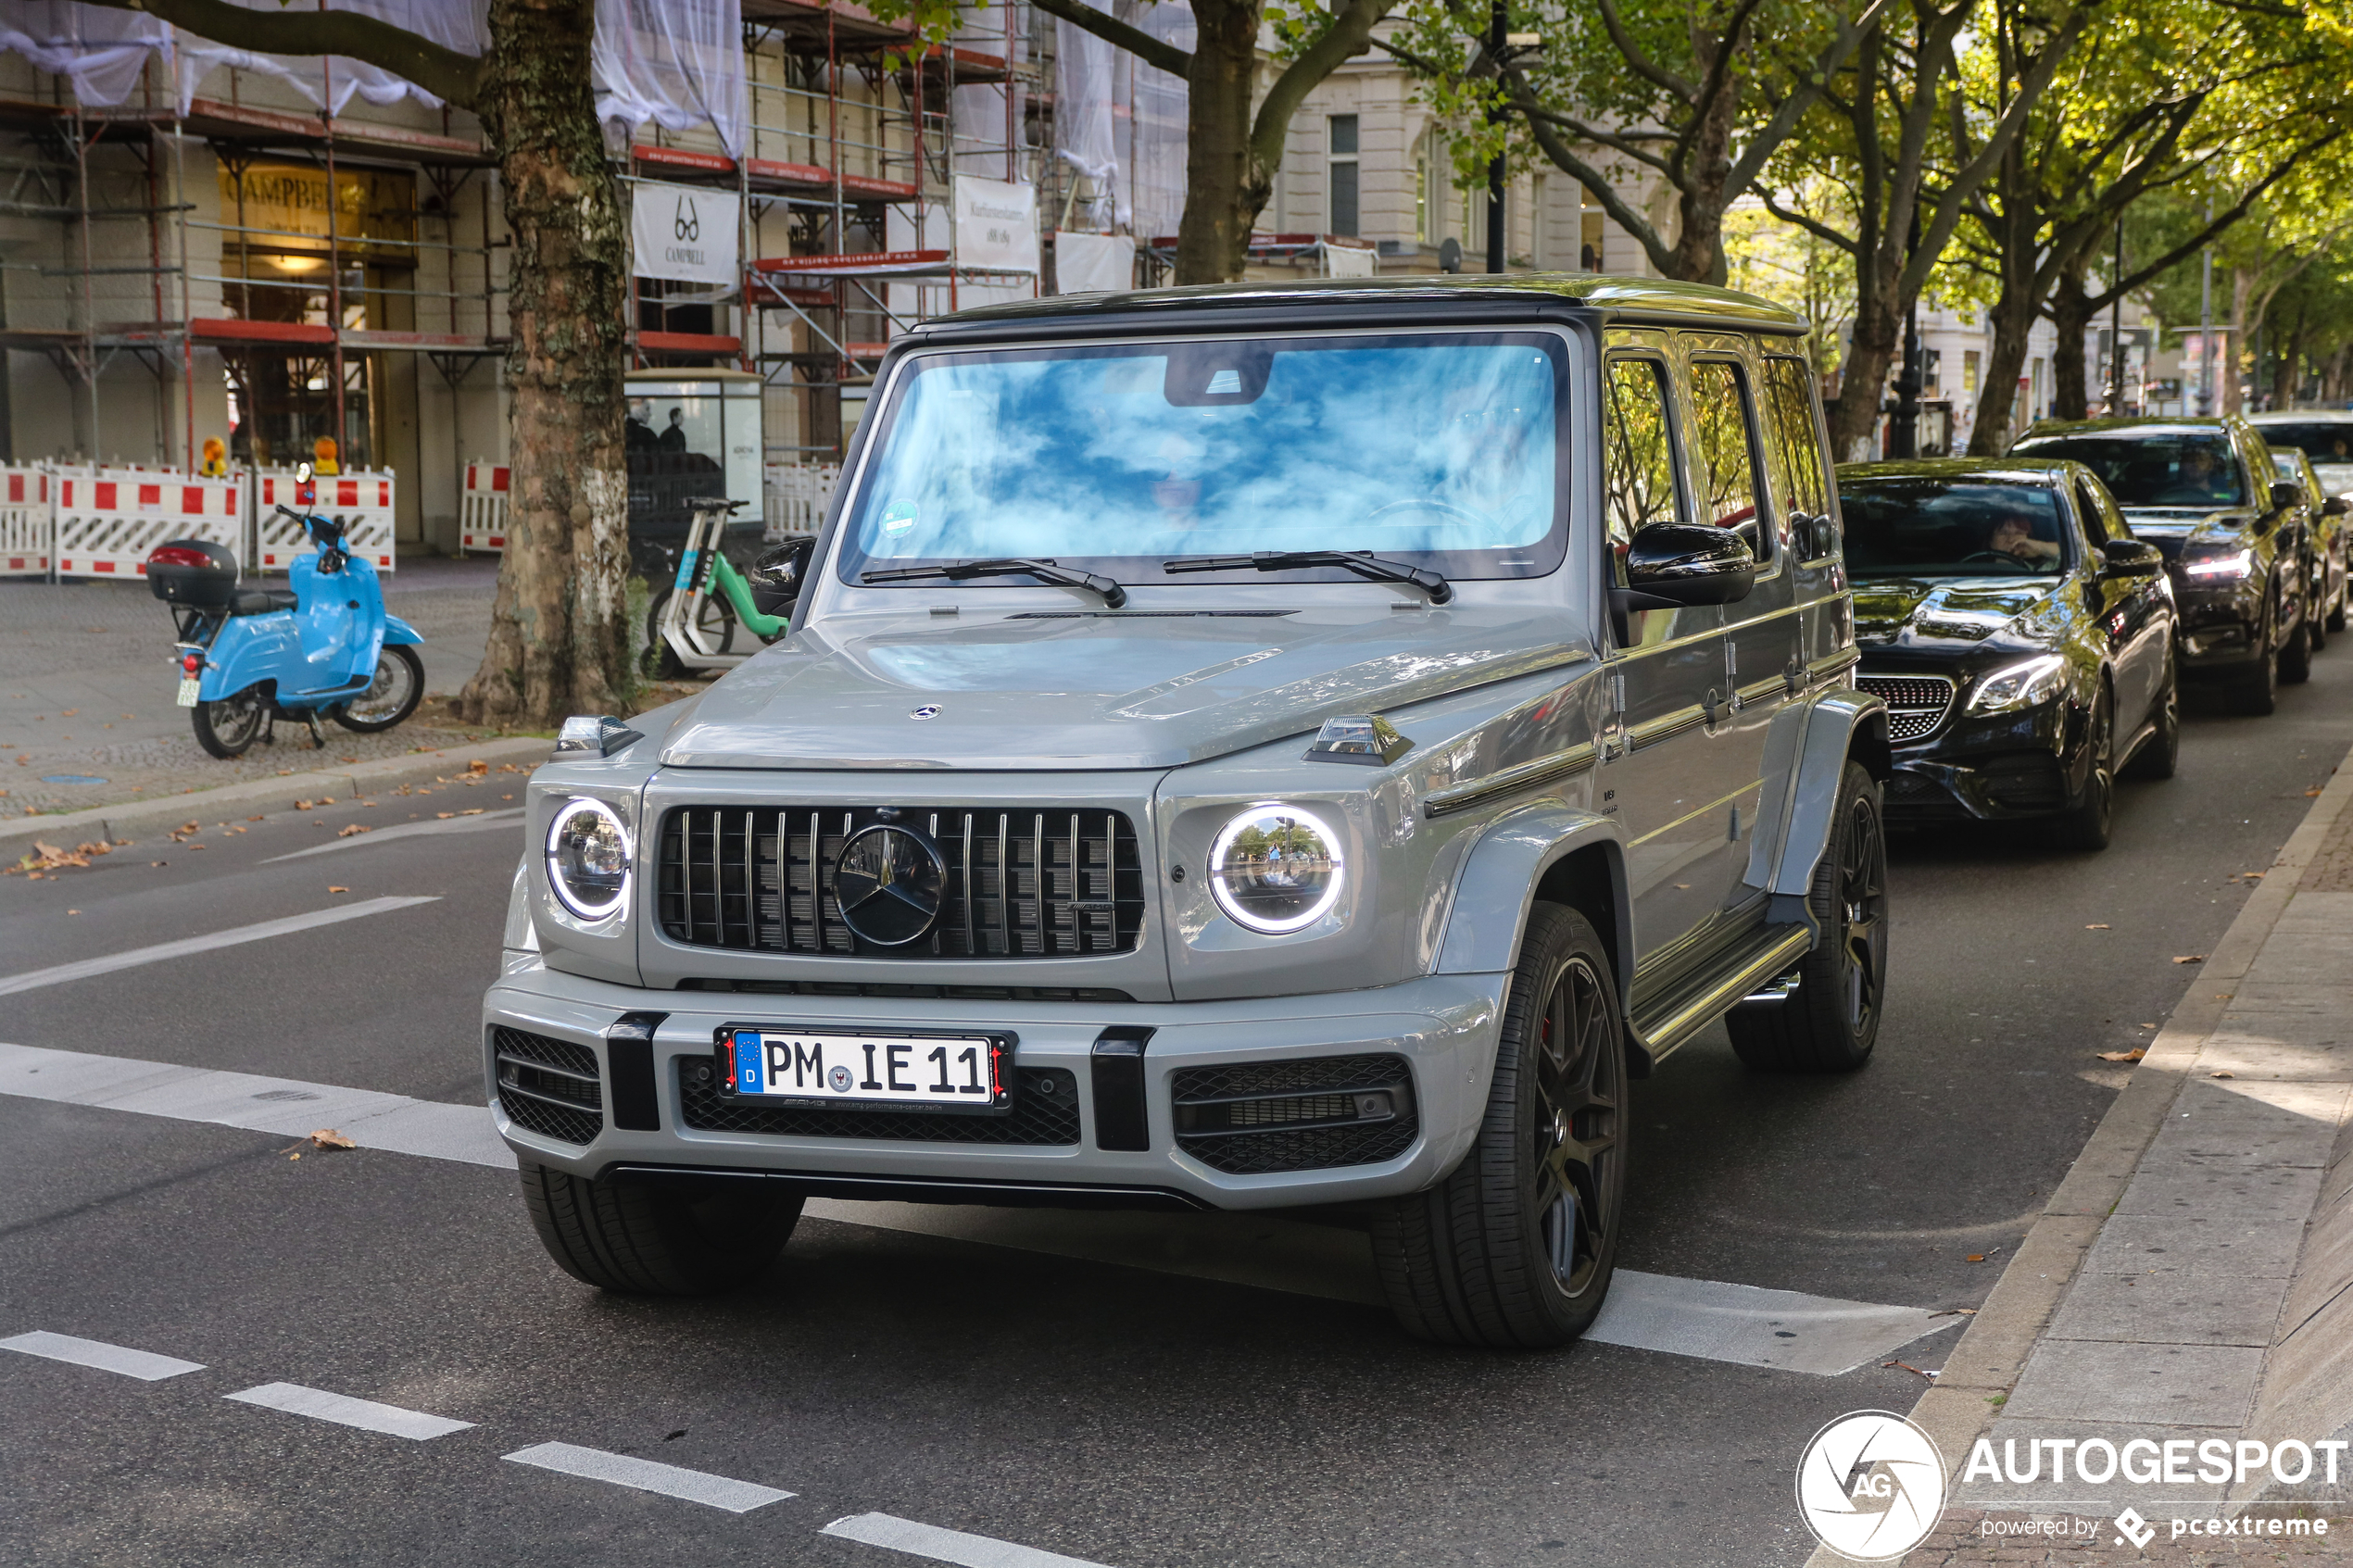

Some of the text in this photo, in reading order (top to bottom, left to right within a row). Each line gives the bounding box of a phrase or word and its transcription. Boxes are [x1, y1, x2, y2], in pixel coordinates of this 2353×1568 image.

[665, 247, 706, 266] CAMPBELL
[894, 504, 904, 518] 4
[745, 1069, 755, 1083] D
[764, 1040, 824, 1088] PM
[860, 1044, 917, 1092] IE
[928, 1046, 986, 1094] 11
[835, 1100, 943, 1112] www.amg-performance-center.berlin
